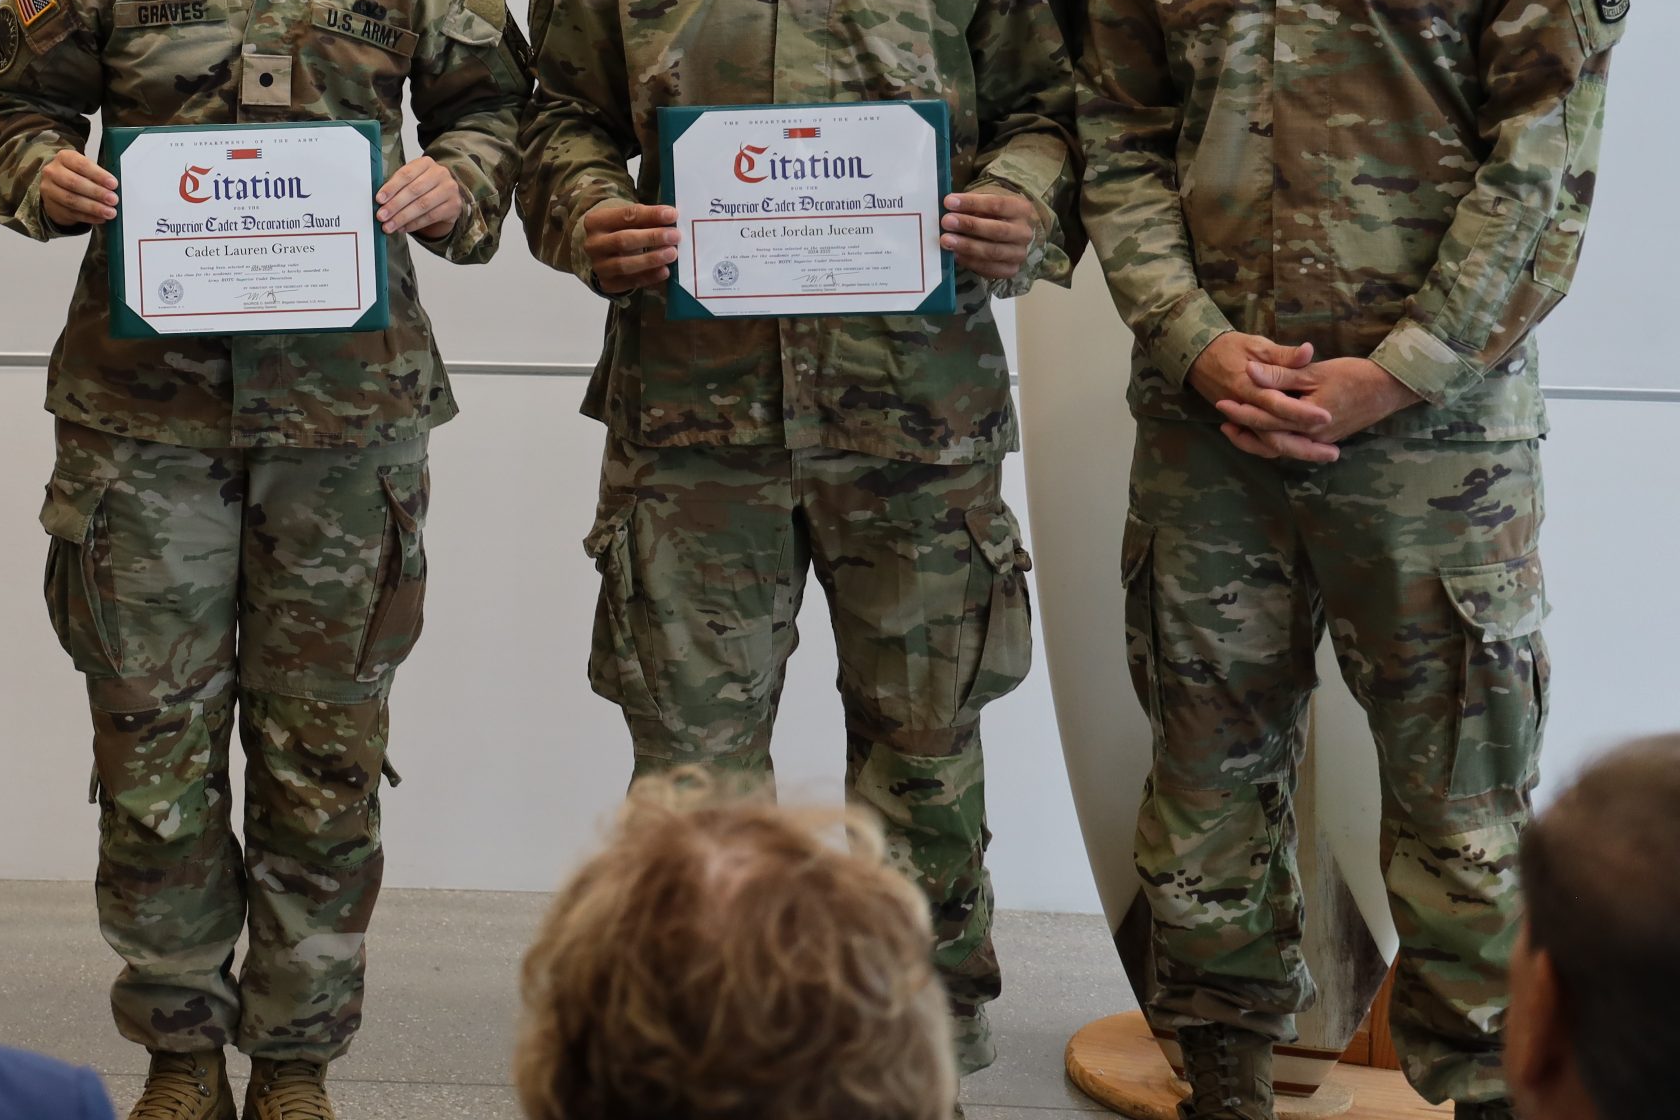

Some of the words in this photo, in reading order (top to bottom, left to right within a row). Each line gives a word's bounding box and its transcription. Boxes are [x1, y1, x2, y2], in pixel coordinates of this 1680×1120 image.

[137, 1, 204, 23] GRAVES
[326, 8, 356, 33] U.S.
[360, 19, 404, 50] ARMY
[734, 141, 874, 184] Citation
[179, 162, 312, 204] Citation
[708, 198, 759, 217] Superior
[761, 197, 796, 213] Cadet
[798, 195, 862, 212] Decoration
[863, 193, 904, 209] Award
[155, 218, 204, 236] Superior
[205, 217, 238, 232] Cadet
[240, 215, 301, 231] Decoration
[302, 213, 341, 229] Award
[740, 226, 777, 239] Cadet
[780, 224, 824, 238] Jordan
[827, 222, 874, 236] Juceam
[184, 245, 221, 258] Cadet
[224, 244, 268, 257] Lauren
[271, 241, 315, 255] Graves
